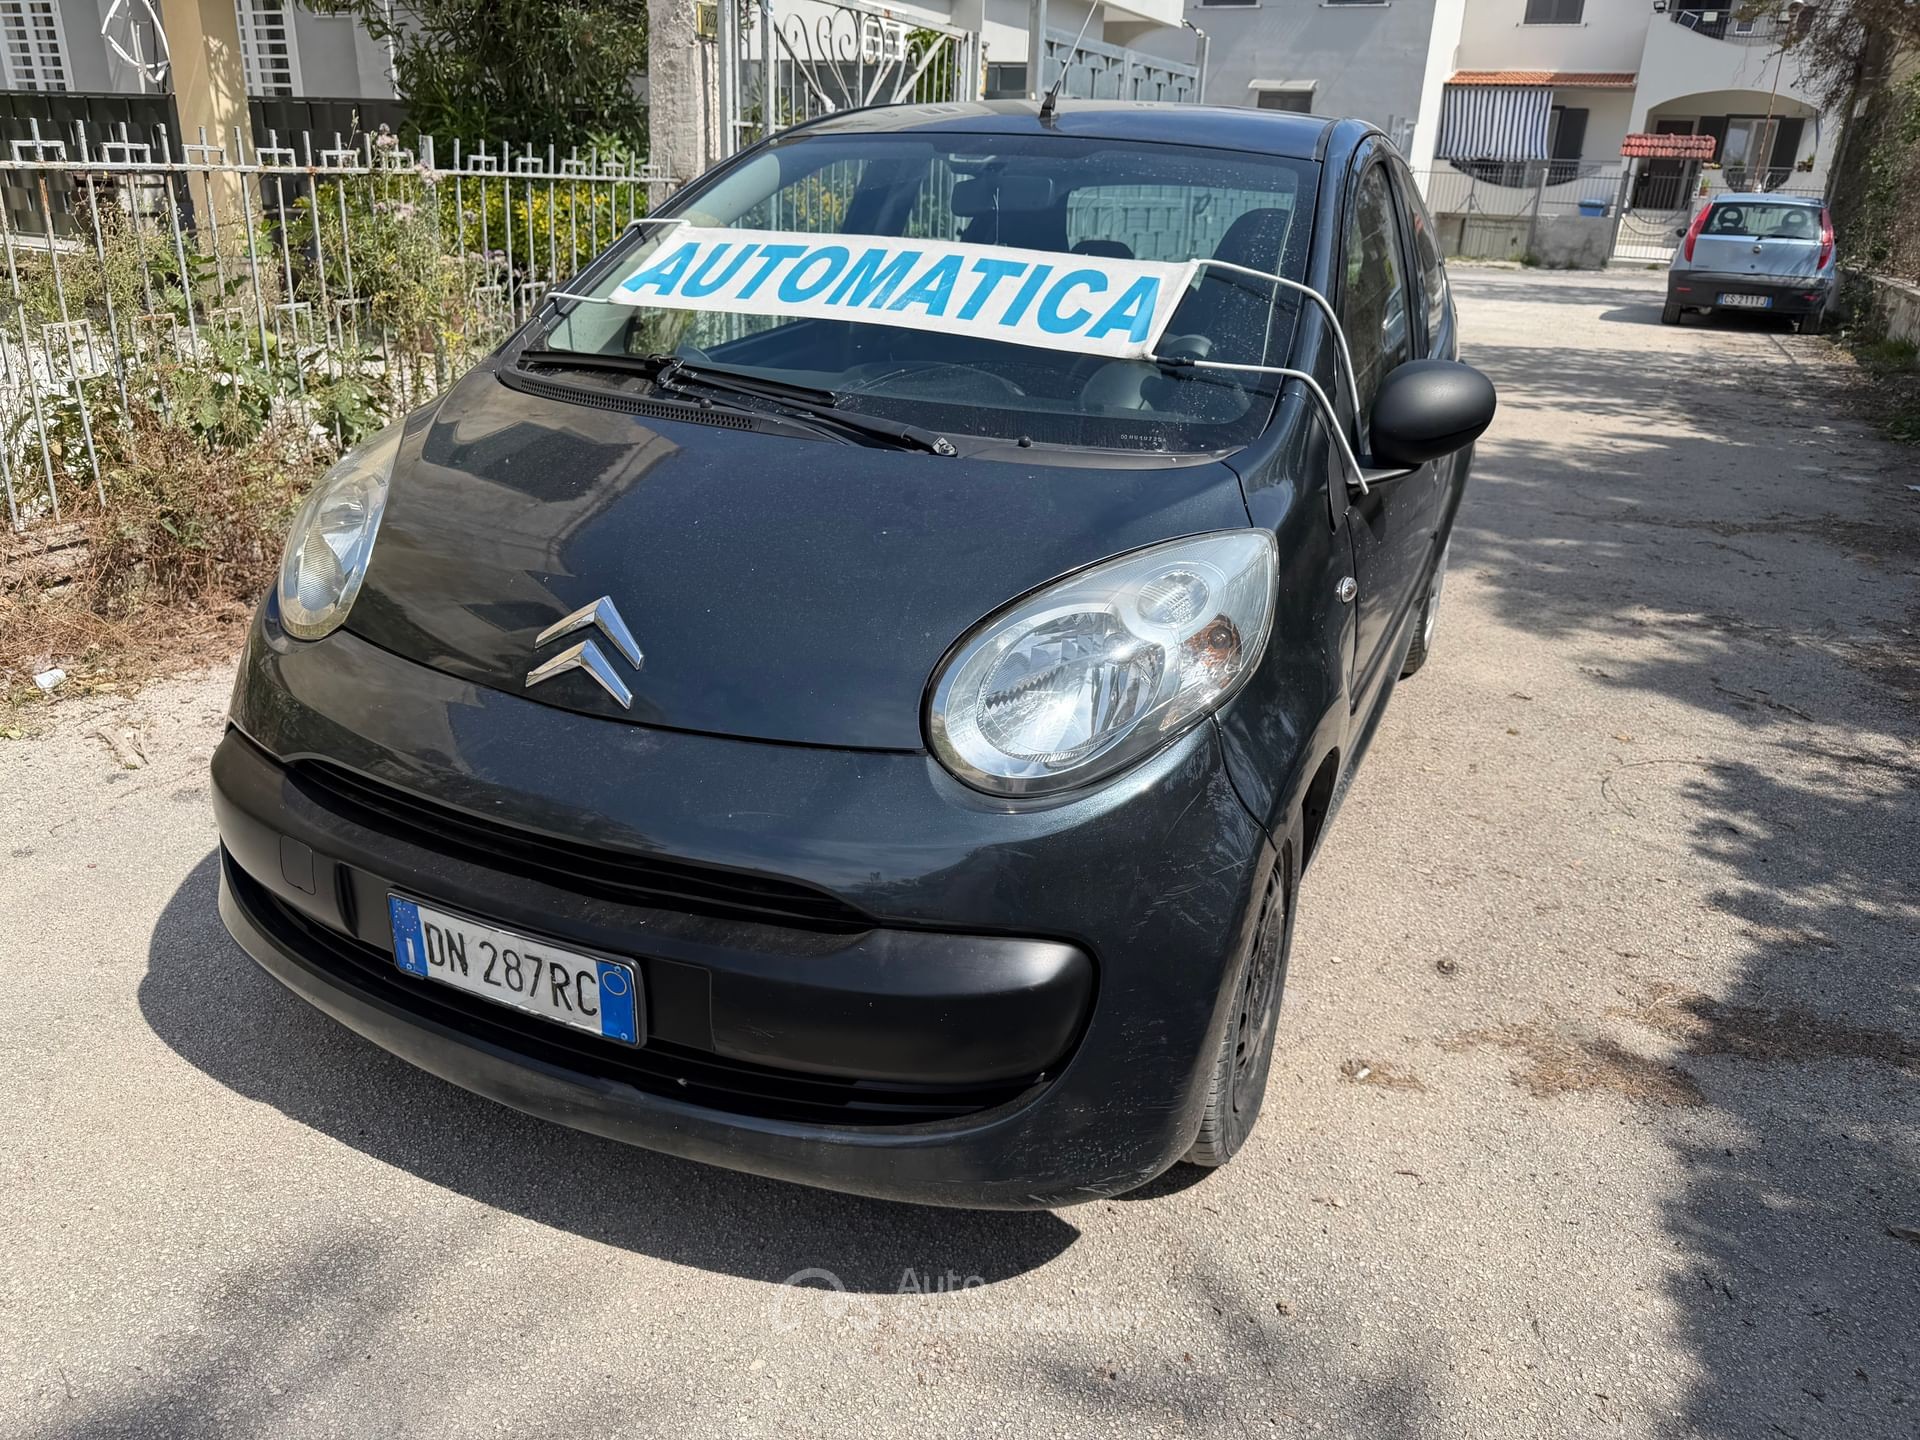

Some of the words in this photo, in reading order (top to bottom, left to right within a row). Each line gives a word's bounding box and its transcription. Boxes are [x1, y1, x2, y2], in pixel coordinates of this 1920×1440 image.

[621, 241, 1162, 344] AUTOMATICA
[424, 921, 468, 977] DN
[479, 941, 598, 1017] 287RC
